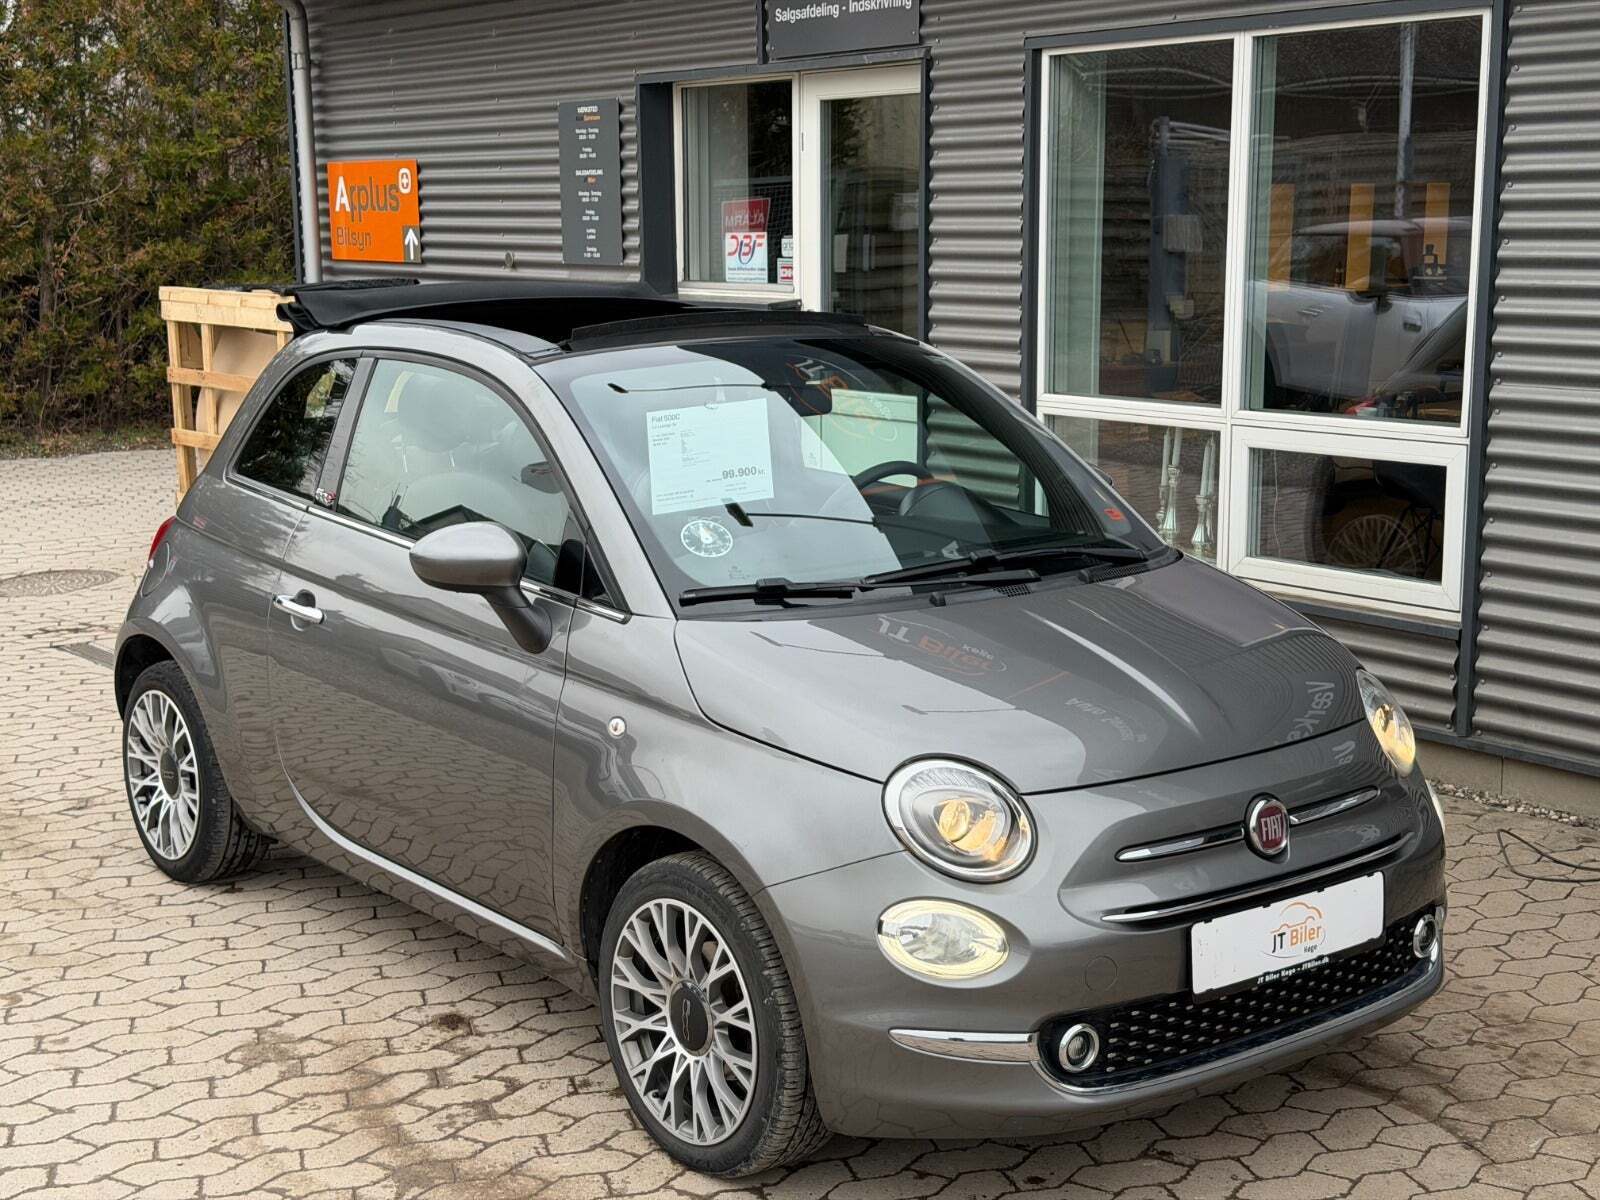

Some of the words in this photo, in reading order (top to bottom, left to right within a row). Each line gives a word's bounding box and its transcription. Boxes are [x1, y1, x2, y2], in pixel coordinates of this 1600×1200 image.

[775, 3, 840, 23] Salgsafdeling
[336, 226, 372, 251] Bilsyn
[722, 466, 757, 480] 99.900
[1260, 813, 1282, 842] FIAT
[1272, 932, 1286, 953] JT
[1290, 925, 1322, 948] Biler
[1265, 973, 1280, 982] Biler
